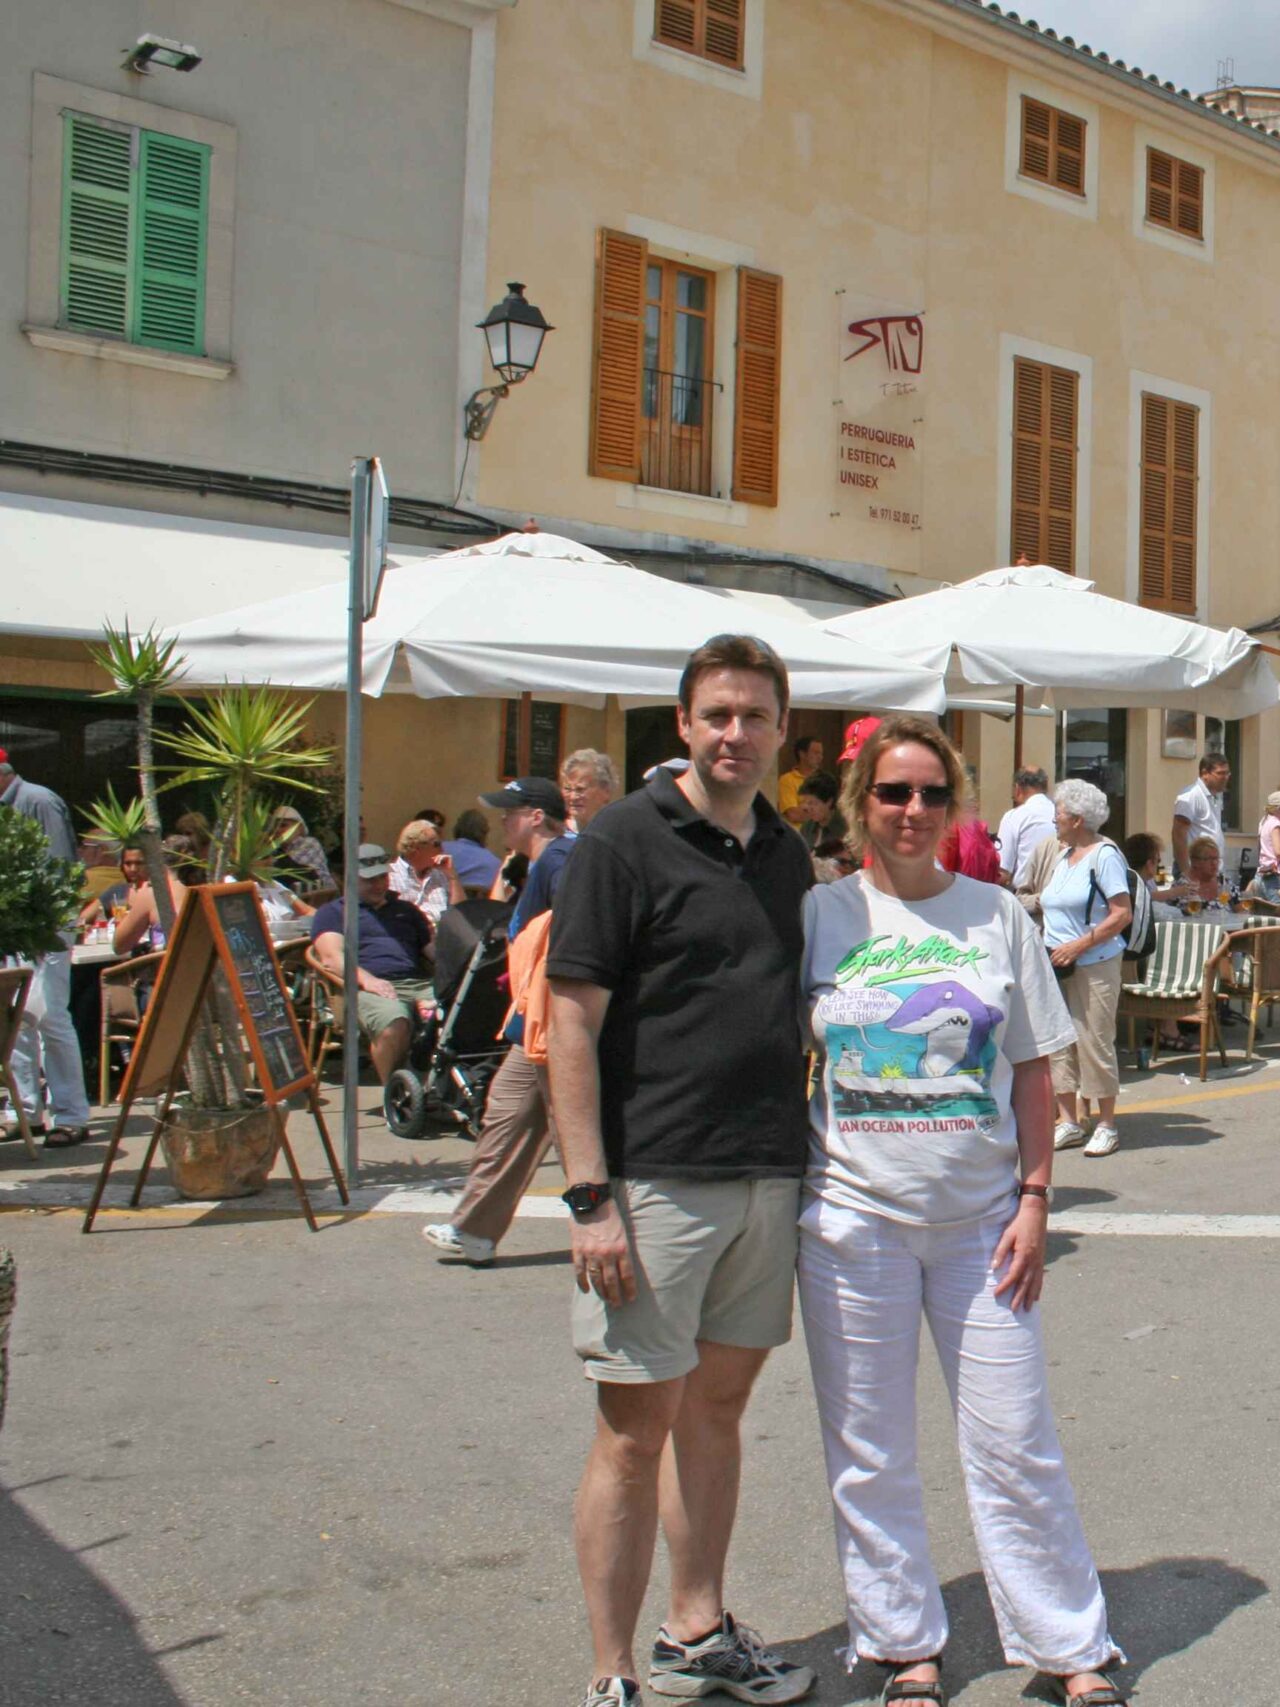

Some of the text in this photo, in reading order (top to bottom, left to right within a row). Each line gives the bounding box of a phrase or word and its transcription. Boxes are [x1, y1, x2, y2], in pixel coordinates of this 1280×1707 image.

[841, 422, 915, 451] PERRUQUERIA
[841, 445, 844, 459] I
[840, 470, 879, 490] UNISEX
[862, 1120, 904, 1133] OCEAN
[907, 1118, 976, 1133] POLLUTION
